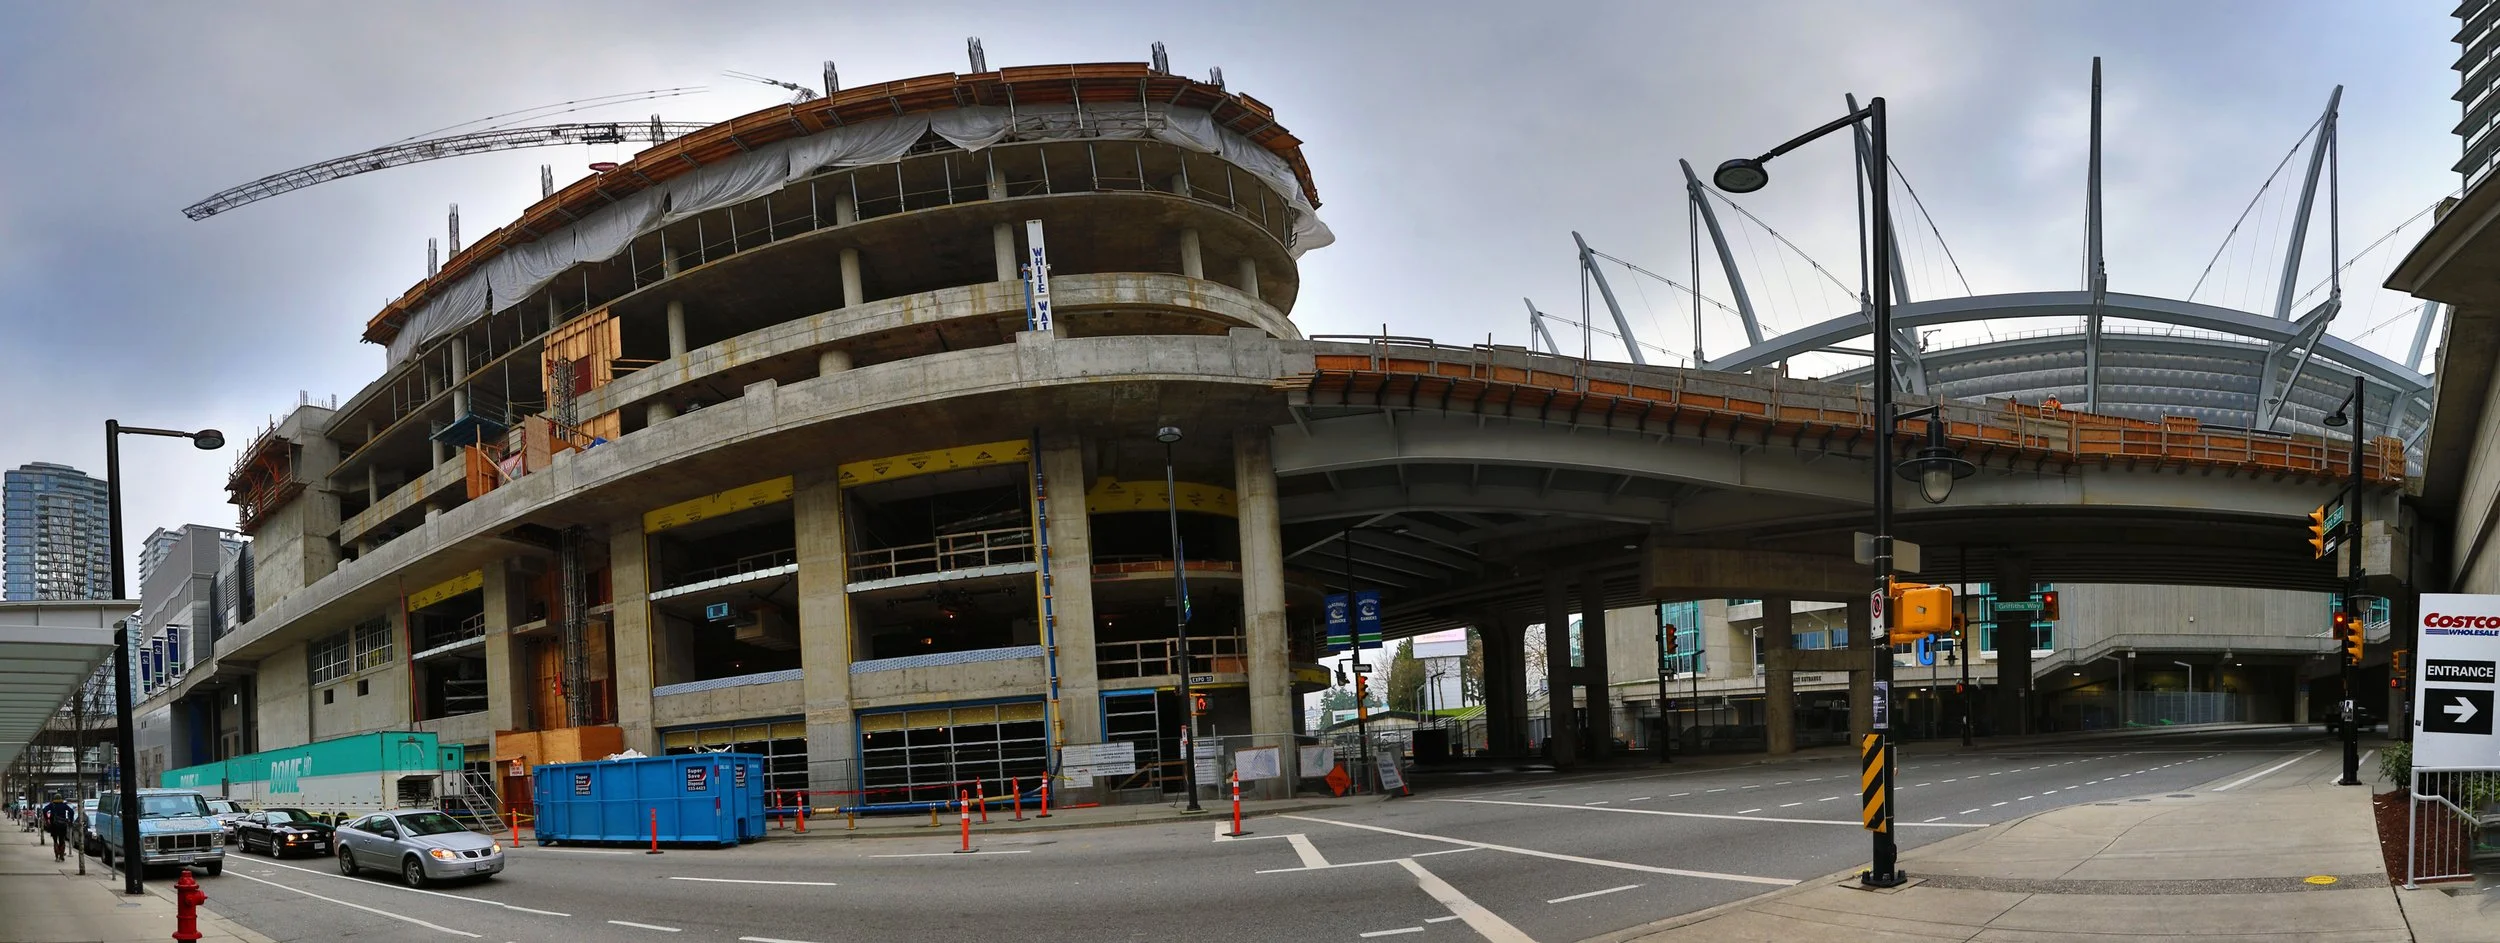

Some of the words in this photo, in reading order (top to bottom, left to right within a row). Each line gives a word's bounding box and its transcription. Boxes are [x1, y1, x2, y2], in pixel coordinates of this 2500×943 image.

[1032, 247, 1045, 293] WHITE
[1038, 301, 1048, 330] WAT
[2325, 519, 2333, 531] Expo
[2424, 613, 2500, 629] COSTCO
[2427, 665, 2494, 677] ENTRANCE
[269, 758, 302, 793] DOME
